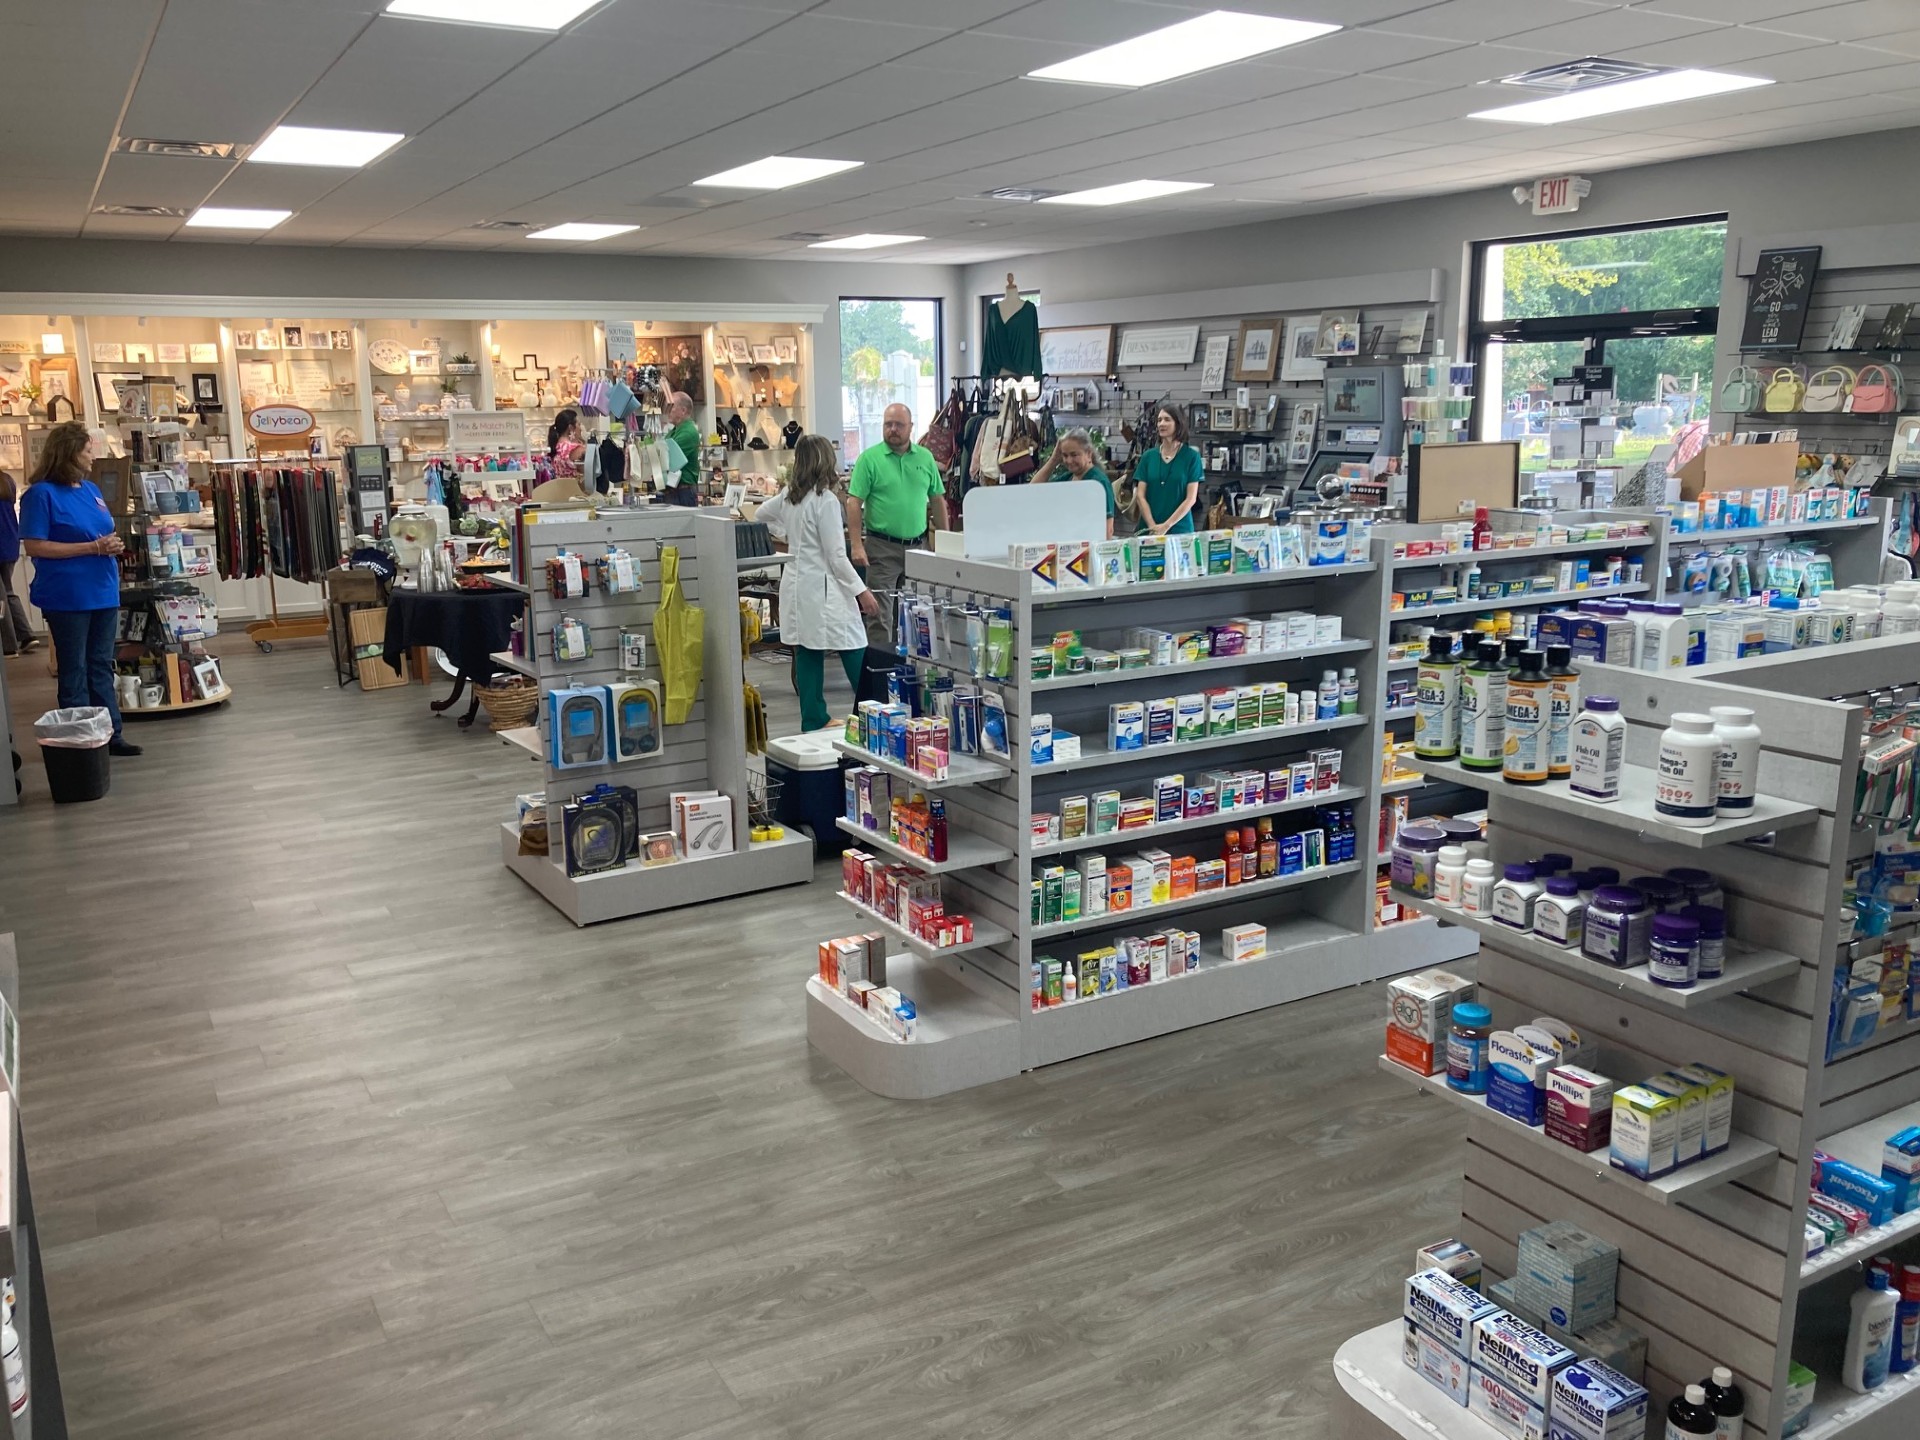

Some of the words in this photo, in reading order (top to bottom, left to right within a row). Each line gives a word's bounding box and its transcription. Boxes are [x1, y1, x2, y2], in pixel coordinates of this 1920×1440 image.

[1540, 178, 1569, 209] EXIT
[1769, 301, 1781, 312] GO
[1762, 327, 1779, 338] LEAD
[255, 414, 309, 428] jellybean
[456, 422, 470, 430] Mix
[471, 422, 478, 430] &
[479, 422, 505, 430] Match
[1770, 490, 1779, 521] BAND-AID
[1237, 529, 1266, 538] FLONASE
[1320, 540, 1343, 548] Nasacort
[1509, 582, 1525, 590] Advil
[1409, 592, 1427, 602] Advil
[1319, 752, 1341, 761] Coricidin
[1575, 745, 1589, 754] Fish
[1589, 747, 1600, 758] Oil
[1673, 768, 1684, 776] Oil
[1283, 845, 1301, 855] NyQuil
[1172, 867, 1195, 877] DayQuil
[1491, 1040, 1534, 1066] Florastor
[1828, 1174, 1879, 1204] Fixodent
[1410, 1285, 1463, 1327] NeilMed
[1413, 1301, 1435, 1321] SINUS
[1435, 1314, 1459, 1337] RINSE
[1501, 1313, 1567, 1353] NeilMed
[1479, 1329, 1539, 1376] NeilMed
[1451, 1360, 1461, 1372] 50
[1482, 1346, 1508, 1369] SINUS
[1507, 1360, 1533, 1384] RINSE
[1589, 1359, 1641, 1390] NeilMed
[1480, 1375, 1501, 1398] 100
[1555, 1381, 1604, 1419] NeilMed
